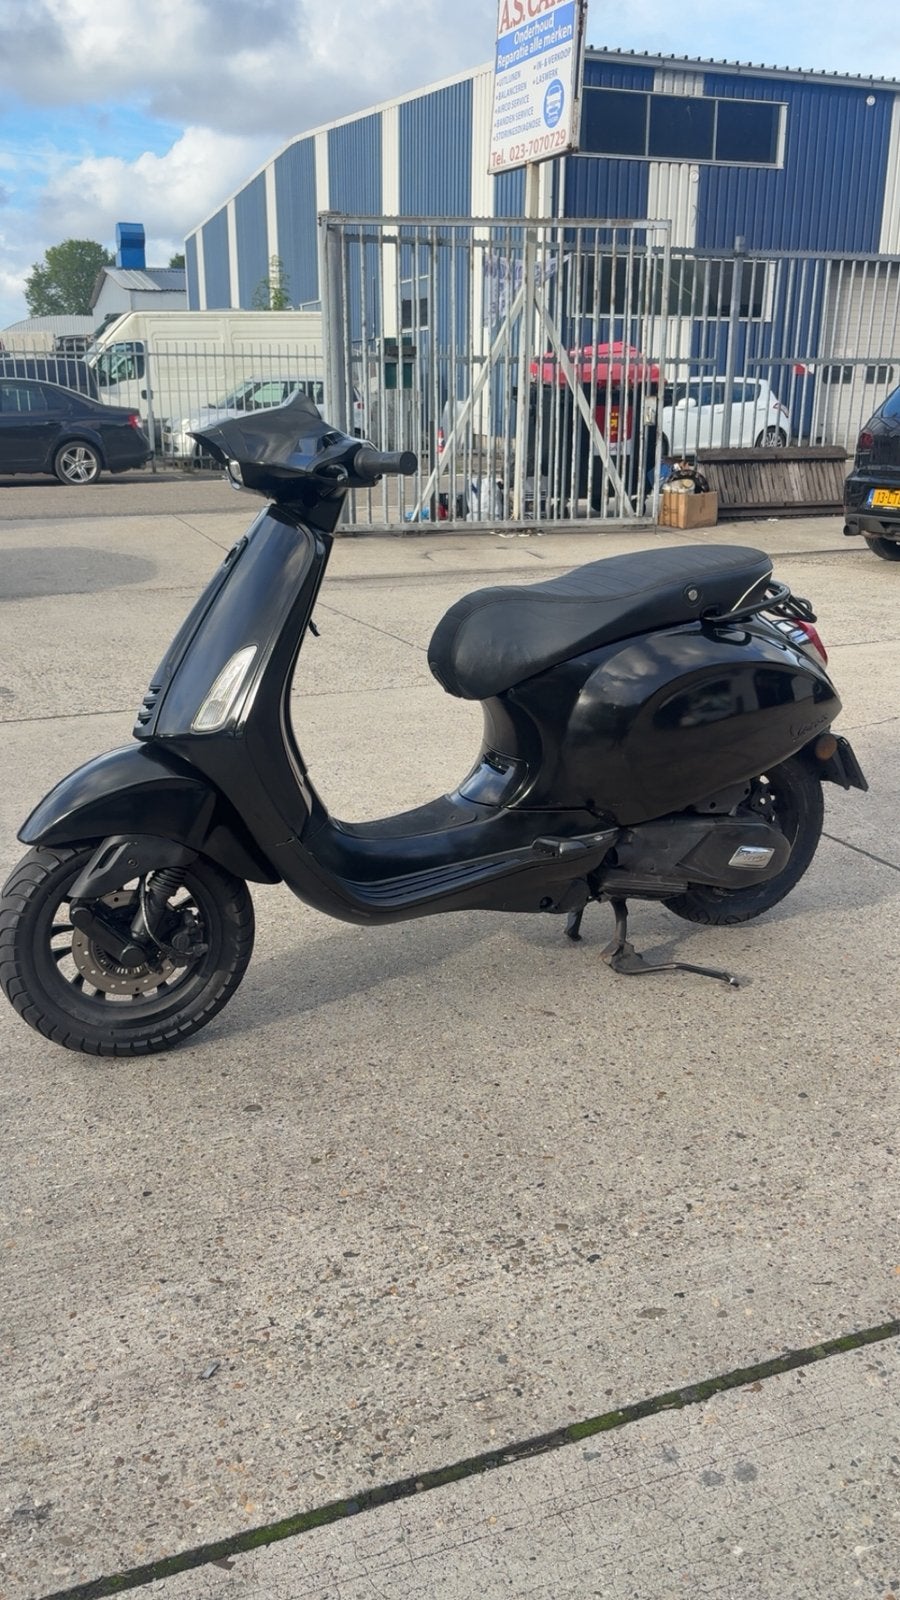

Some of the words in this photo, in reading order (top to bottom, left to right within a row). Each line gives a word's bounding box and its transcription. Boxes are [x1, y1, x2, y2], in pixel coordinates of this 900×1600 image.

[513, 10, 555, 45] Onderhoud
[497, 42, 529, 69] Reparatie
[529, 36, 543, 54] alle
[543, 24, 572, 48] merken
[548, 47, 571, 64] VERKOOP
[536, 68, 558, 85] LASWERK
[498, 82, 527, 101] BALANCEREN
[511, 94, 530, 109] SERVICE
[515, 106, 534, 120] SERVICE
[491, 148, 506, 166] Tel.
[509, 129, 567, 161] 023-7070729
